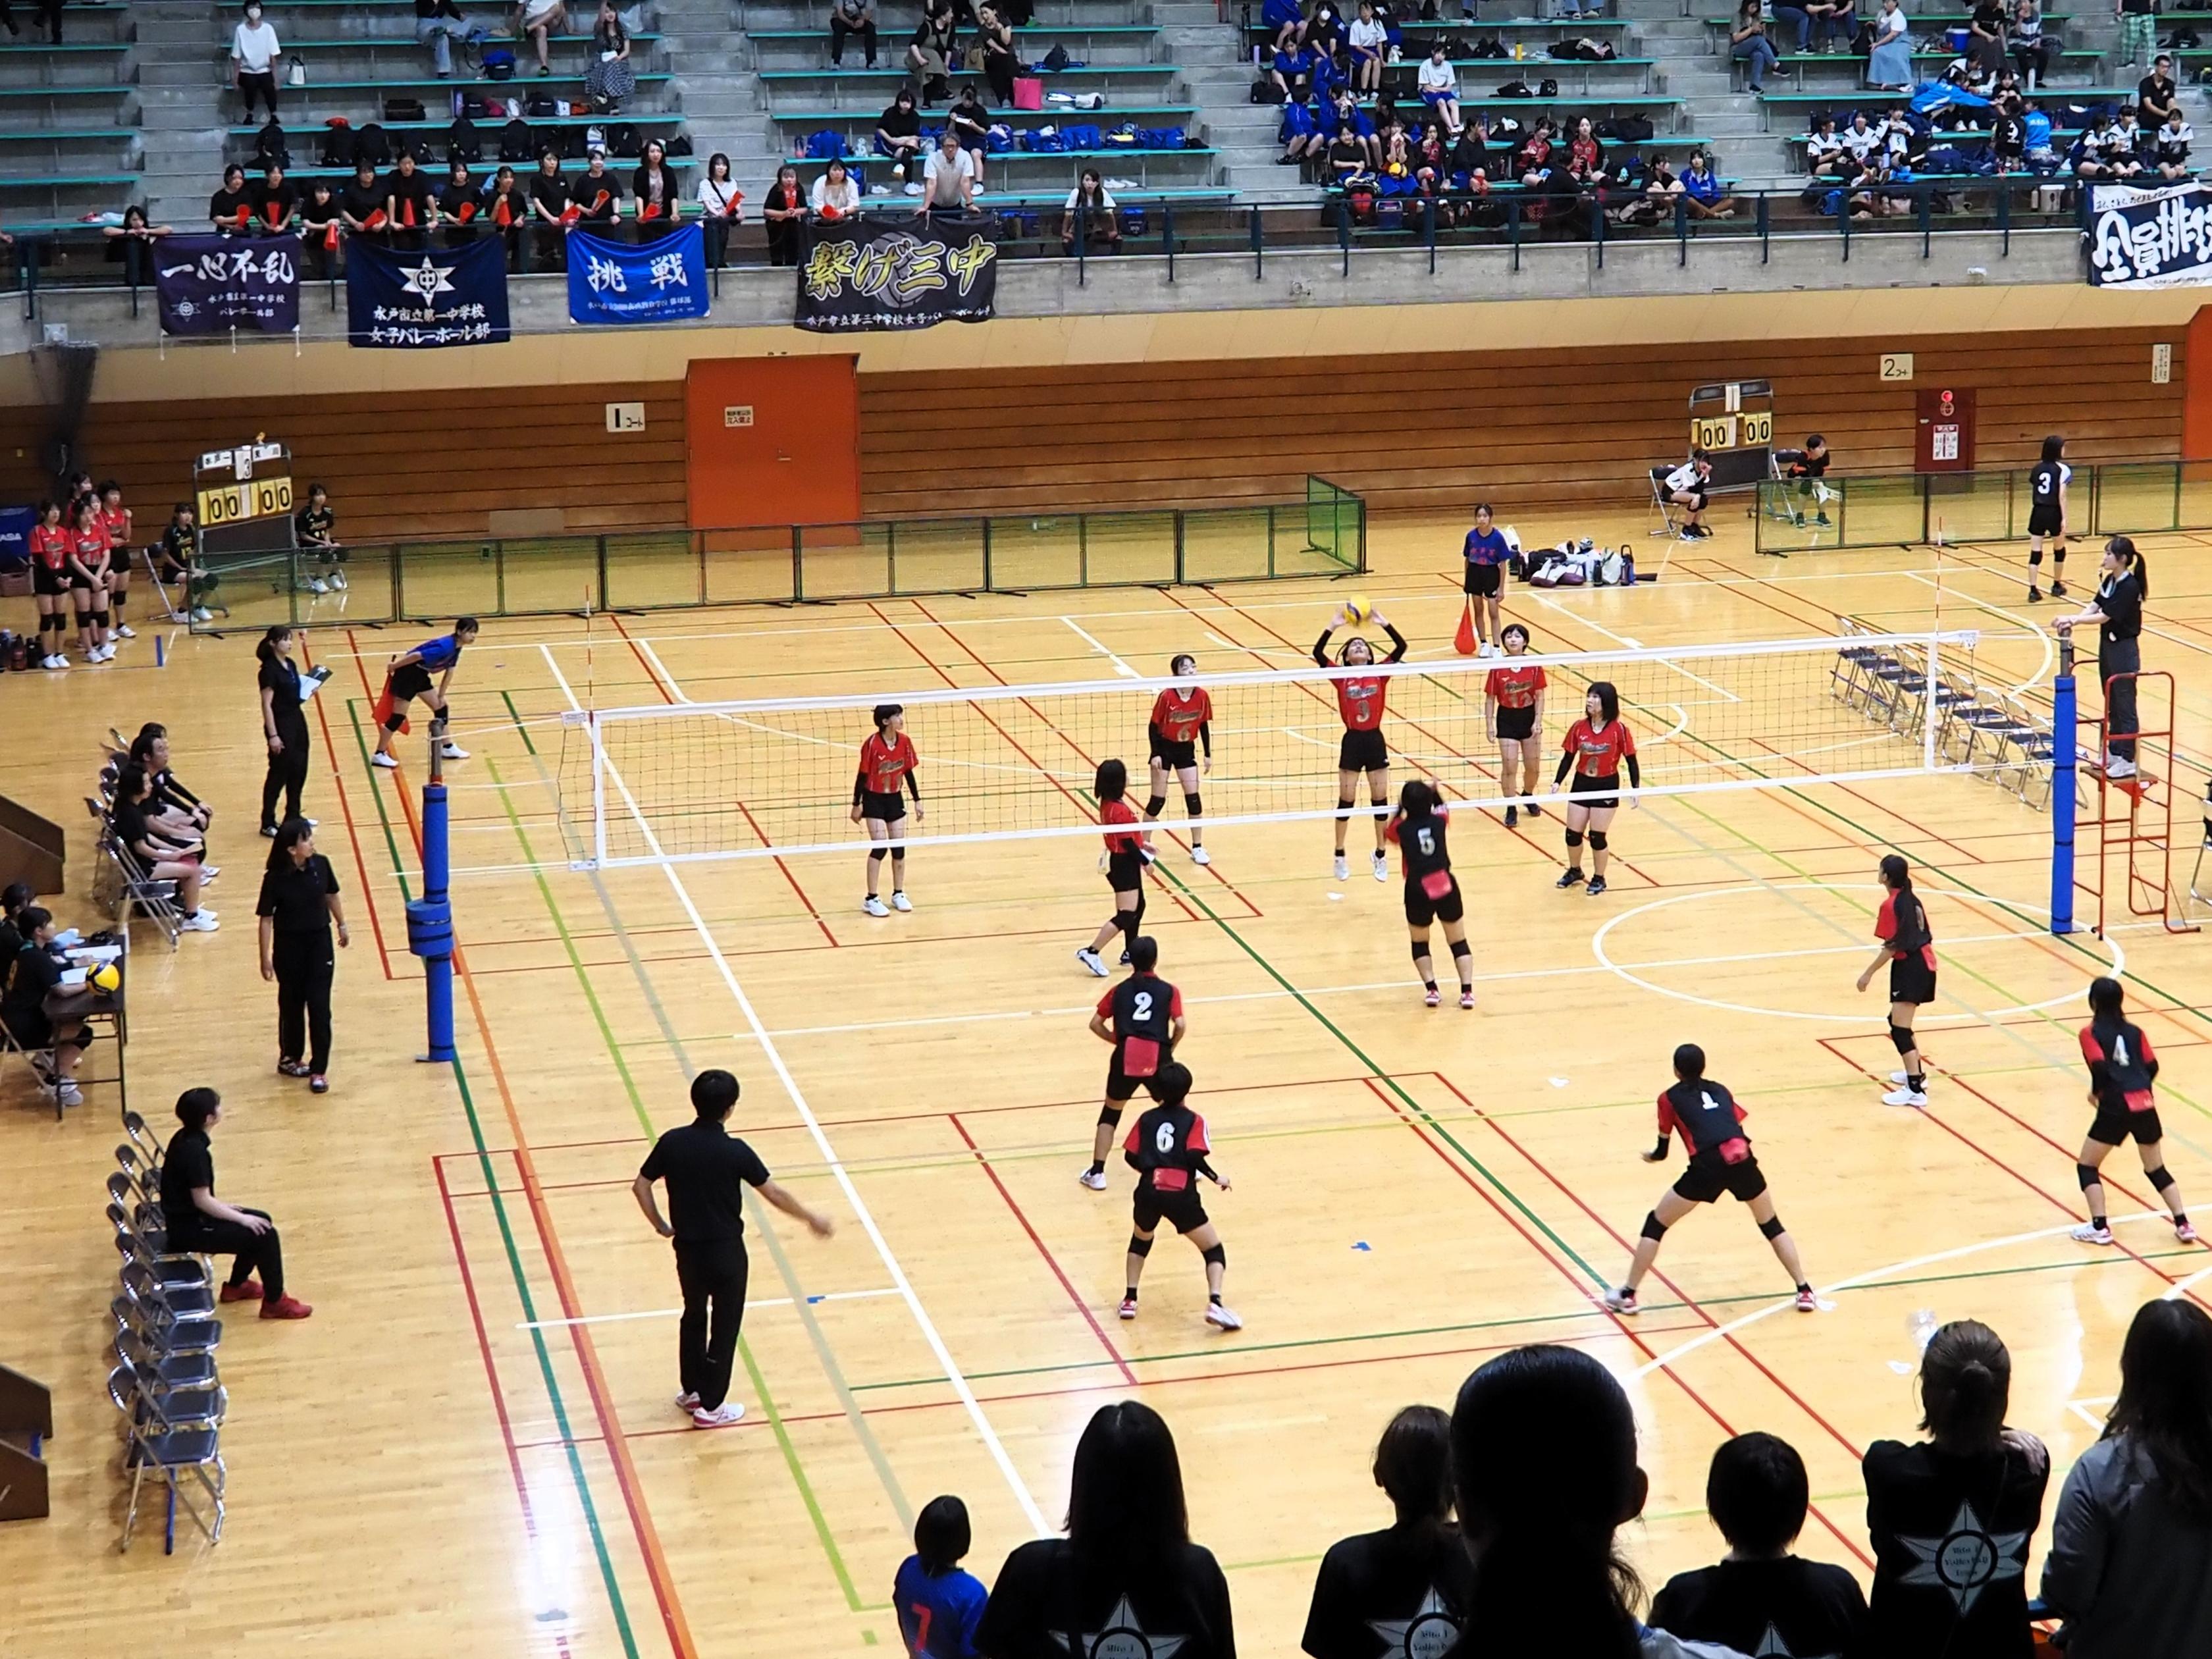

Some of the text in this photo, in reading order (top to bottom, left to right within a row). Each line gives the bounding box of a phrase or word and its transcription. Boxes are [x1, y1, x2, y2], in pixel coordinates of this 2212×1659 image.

[161, 249, 295, 284] 一心不乱
[587, 252, 689, 294] 挑戦
[804, 232, 997, 302] 繋げ三中
[373, 303, 487, 323] 水戸市立第一中学校
[368, 321, 492, 345] 女子バレーボール部
[1703, 420, 1769, 447] 00 00
[2038, 472, 2051, 494] 3
[211, 486, 290, 519] 00 00
[1417, 827, 1436, 856] 5
[1132, 991, 1153, 1021] 2
[2112, 1034, 2130, 1066] 4
[1700, 1090, 1720, 1110] 1
[1156, 1122, 1175, 1153] 6
[911, 1602, 932, 1652] 7
